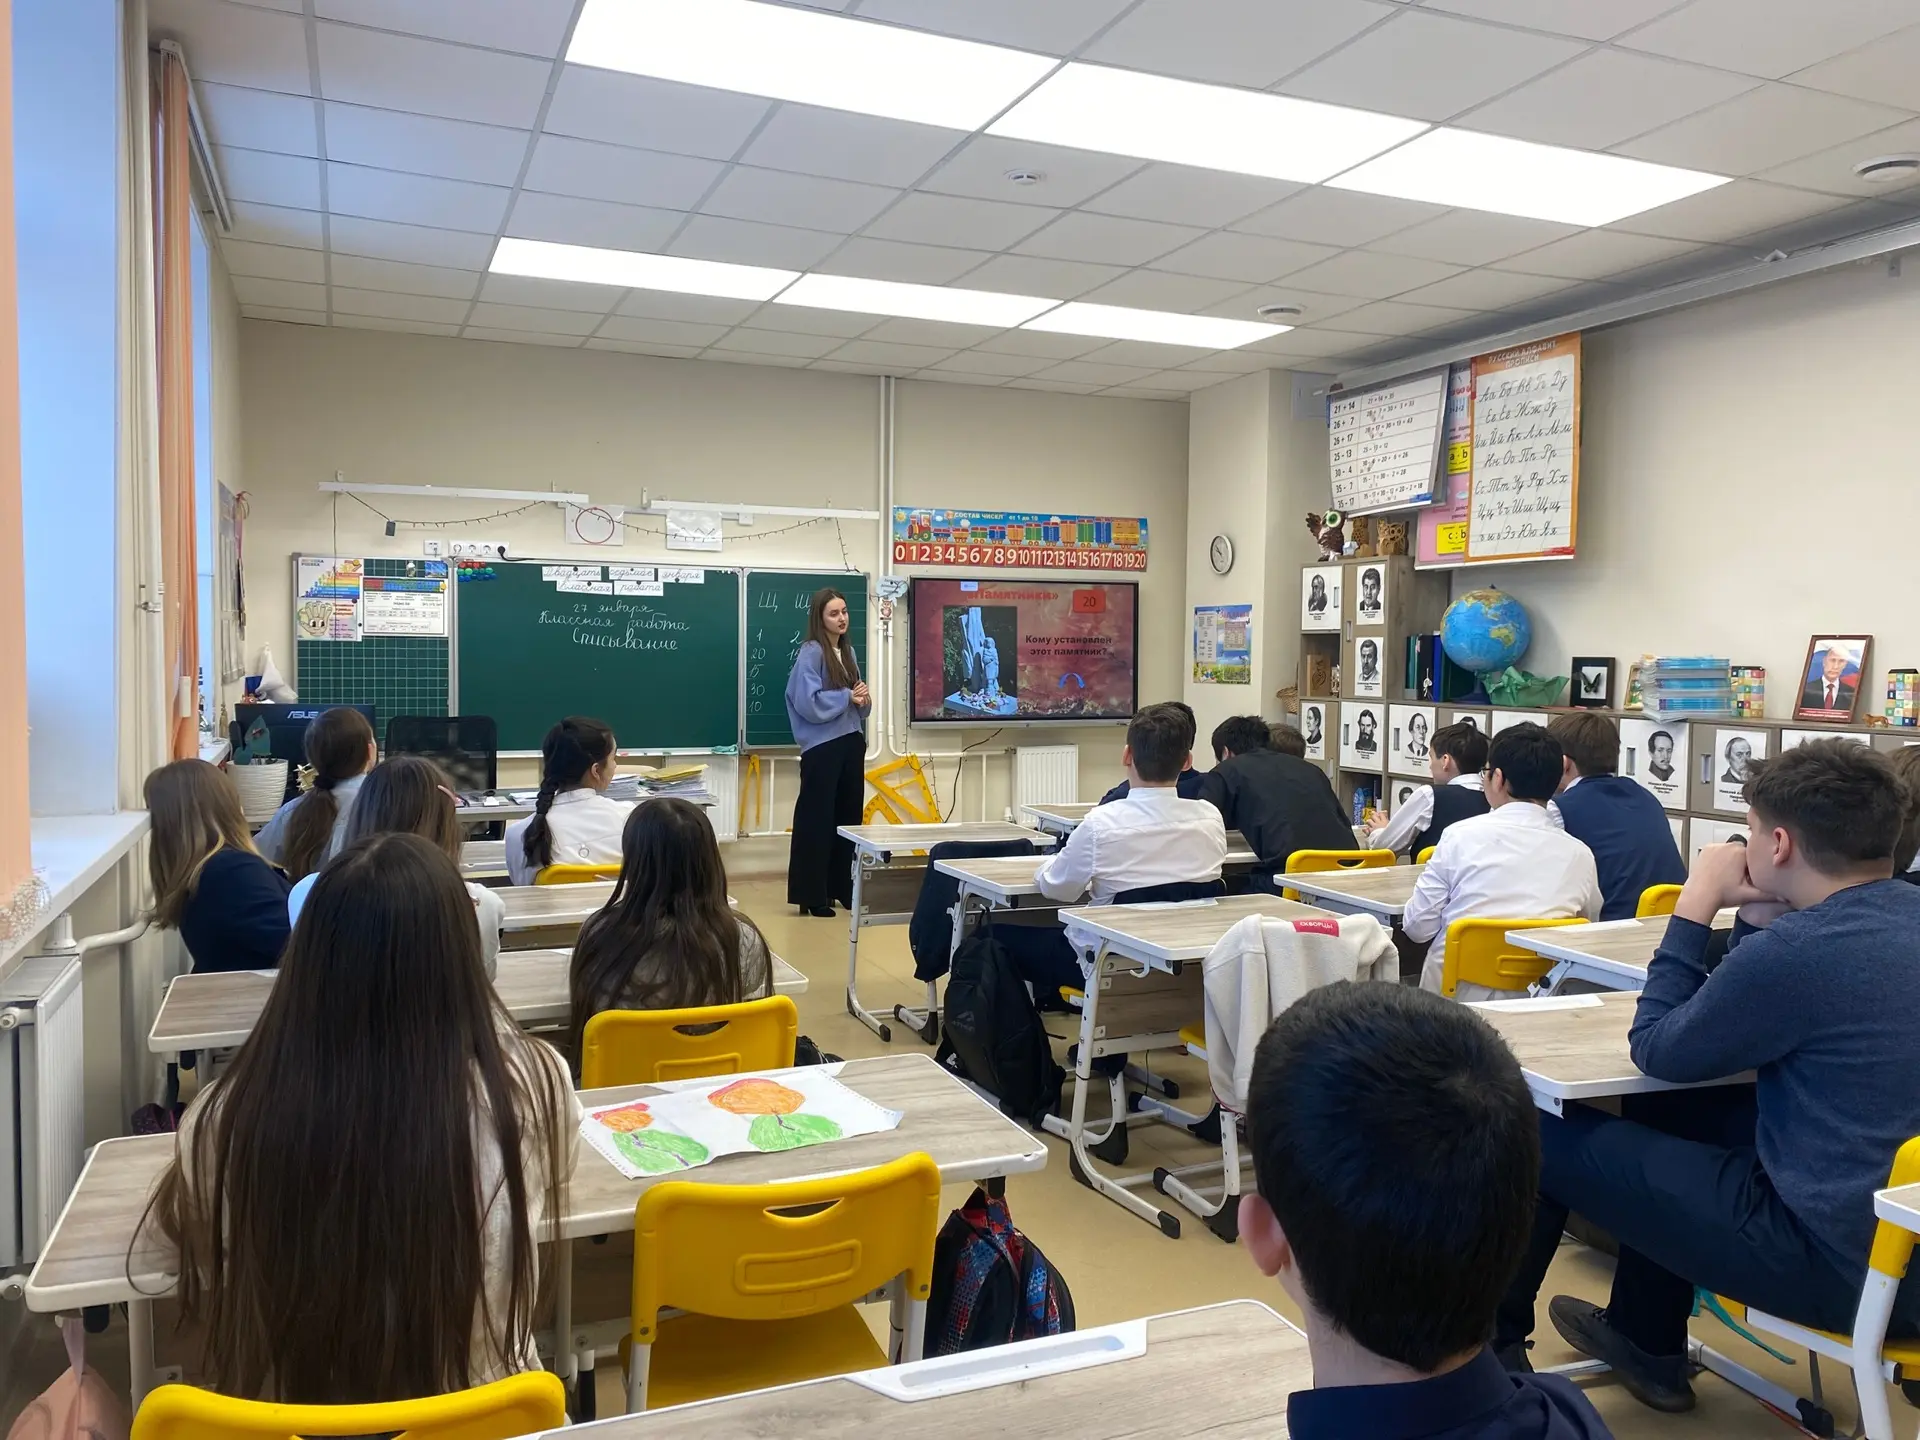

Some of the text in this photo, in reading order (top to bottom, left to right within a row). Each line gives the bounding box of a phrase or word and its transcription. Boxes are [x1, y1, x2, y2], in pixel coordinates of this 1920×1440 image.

[1488, 340, 1556, 364] РУССКИЙ АЛФАВИТ
[1505, 354, 1539, 368] ПРОПИСИ
[1479, 370, 1568, 402] Аа Бб Вв Гг Дд
[1486, 408, 1496, 424] Ее
[1514, 400, 1540, 418] Жж
[1544, 396, 1558, 418] Зз
[1474, 434, 1486, 448] Ии
[1489, 428, 1504, 446] Йй
[1507, 428, 1521, 442] Кк
[1524, 424, 1542, 440] Лл
[1546, 420, 1572, 436] Мм
[1484, 444, 1557, 468] Нн Оо Пп Рр
[1475, 469, 1568, 494] Сс Тт Уу Фф Хх
[1478, 503, 1494, 520] Цц
[1497, 501, 1510, 515] Чч
[1512, 498, 1533, 514] Шш
[1536, 496, 1561, 514] Щщ
[982, 512, 1004, 520] ЧИСЕЛ
[1503, 525, 1515, 540] Ээ
[1518, 523, 1537, 538] Юю
[1540, 521, 1557, 536] Яя
[895, 545, 1146, 568] 0 1 2 3 4 5 6 7 8 9 10 11 12 13 14 15 16 17 18 19 20
[543, 565, 601, 578] Двадцать
[662, 569, 701, 580] января
[559, 579, 612, 592] Классная
[619, 580, 662, 594] работа
[1083, 596, 1096, 607] 20
[572, 600, 654, 618] 27 января
[538, 610, 690, 634] Классная работа
[572, 628, 678, 650] Списывание
[756, 629, 802, 644] 1 2
[1026, 635, 1112, 648] Кому установлен
[751, 648, 766, 660] 20
[1054, 648, 1107, 656] памятник?
[750, 664, 764, 678] 15
[751, 683, 765, 696] 30
[749, 701, 762, 712] 10
